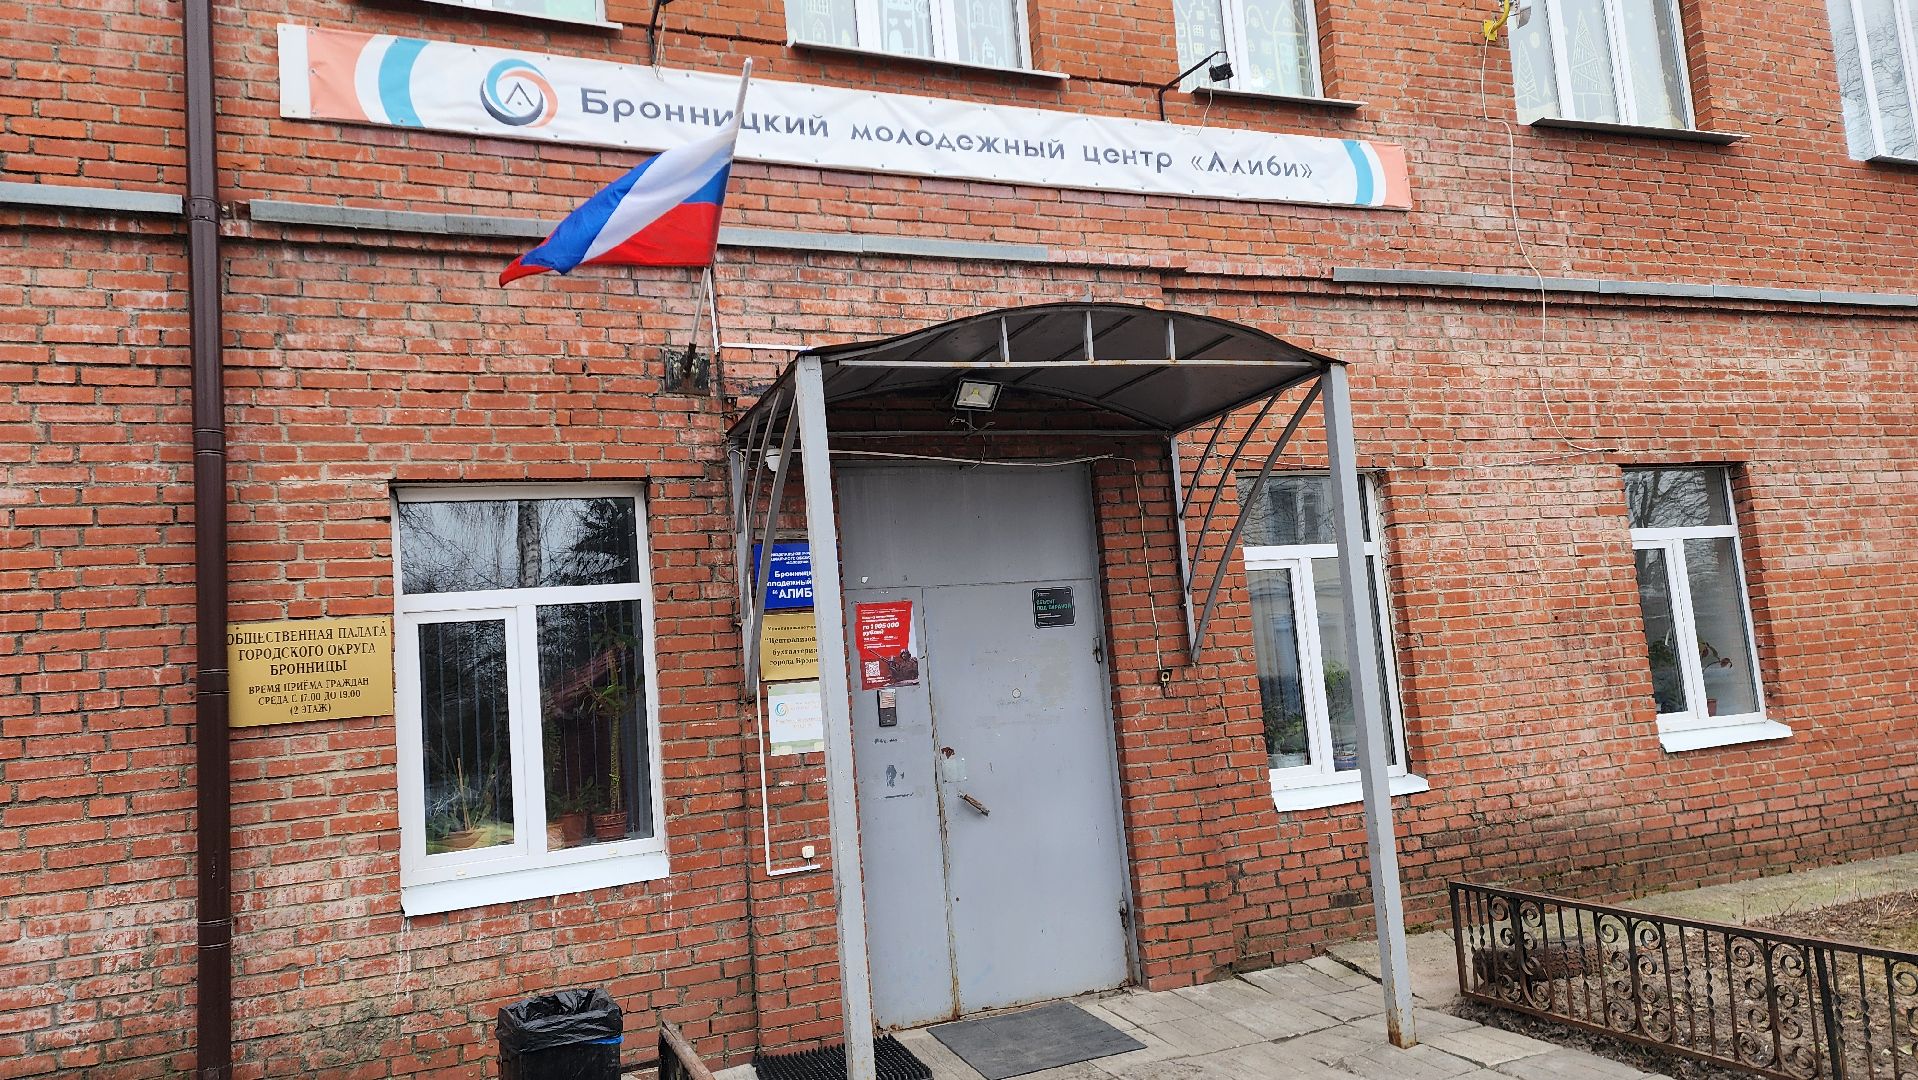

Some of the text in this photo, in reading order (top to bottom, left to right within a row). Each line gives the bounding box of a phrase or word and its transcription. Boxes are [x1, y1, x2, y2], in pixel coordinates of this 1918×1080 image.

[580, 86, 829, 139] Бронницкий
[850, 122, 1065, 160] молодежный
[1083, 144, 1173, 174] центр
[226, 625, 388, 646] ОБЩЕСТВЕННАЯ ПАЛАТА
[238, 642, 377, 661] ГОРОДСКОГО ОКРУГА
[270, 659, 348, 676] БРОННИЦЫ
[248, 683, 281, 695] ВРЕМЯ
[325, 677, 369, 689] ГРАЖДАН
[258, 695, 289, 706] СРЕДА
[300, 692, 321, 703] 17.00
[323, 691, 337, 702] ДО
[339, 689, 361, 699] 19.00
[289, 702, 332, 716] (2 ЭТАЖ)
